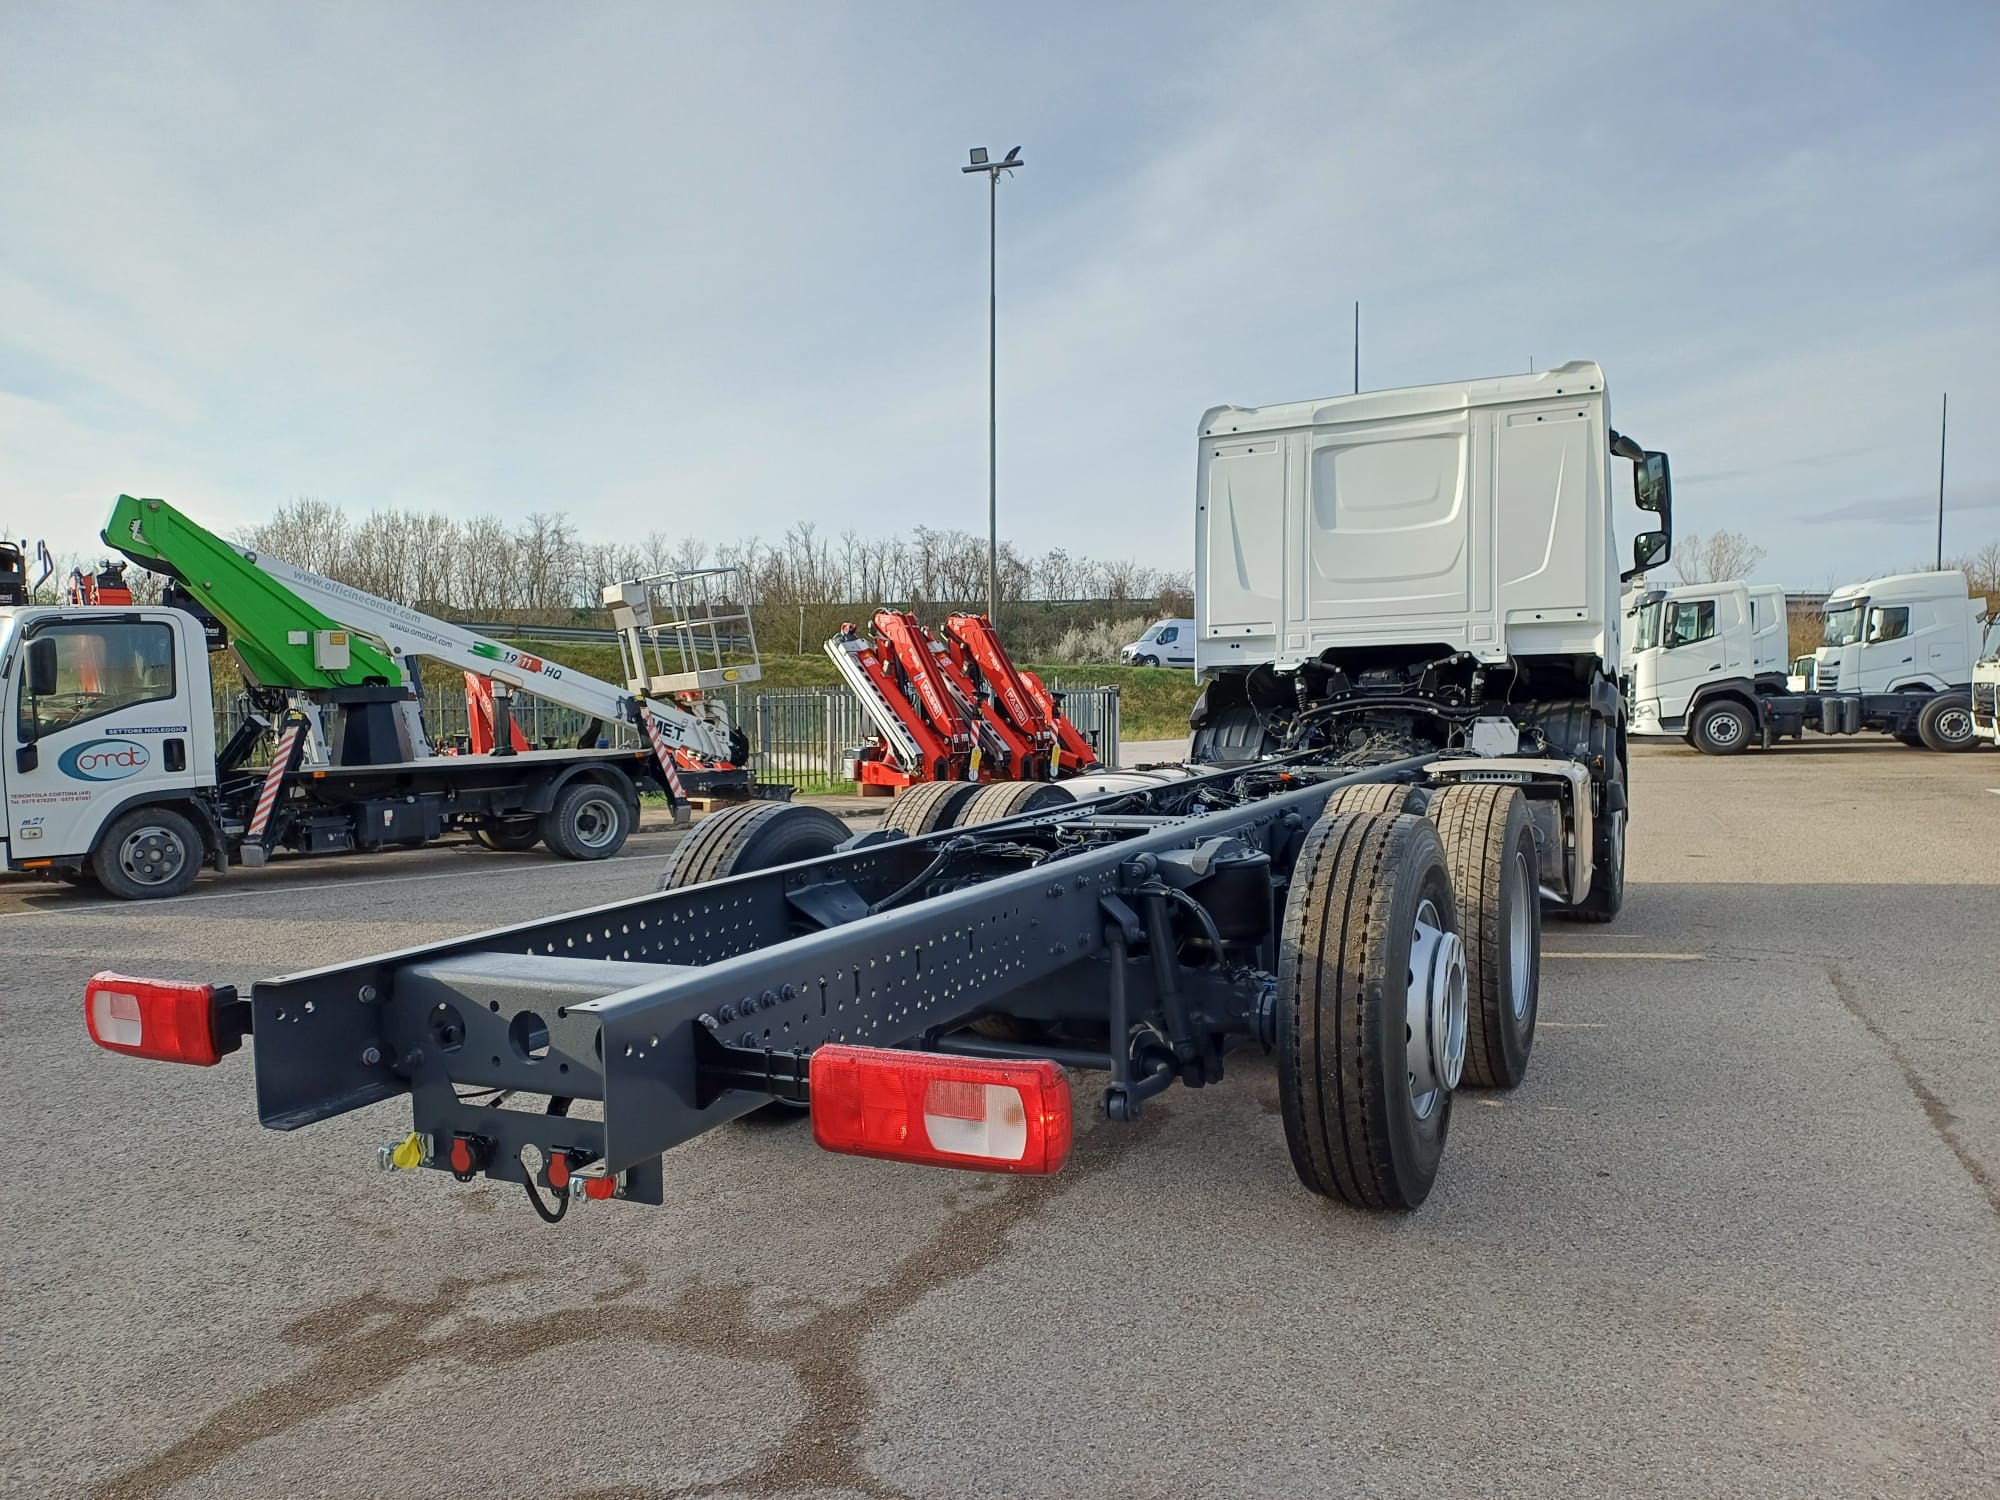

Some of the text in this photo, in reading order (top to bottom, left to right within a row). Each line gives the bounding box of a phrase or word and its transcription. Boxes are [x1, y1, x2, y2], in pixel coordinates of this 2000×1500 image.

[294, 571, 421, 624] www.officinecomet.com
[543, 666, 562, 680] HQ
[922, 682, 941, 716] FASSI
[1007, 690, 1026, 723] FASSI
